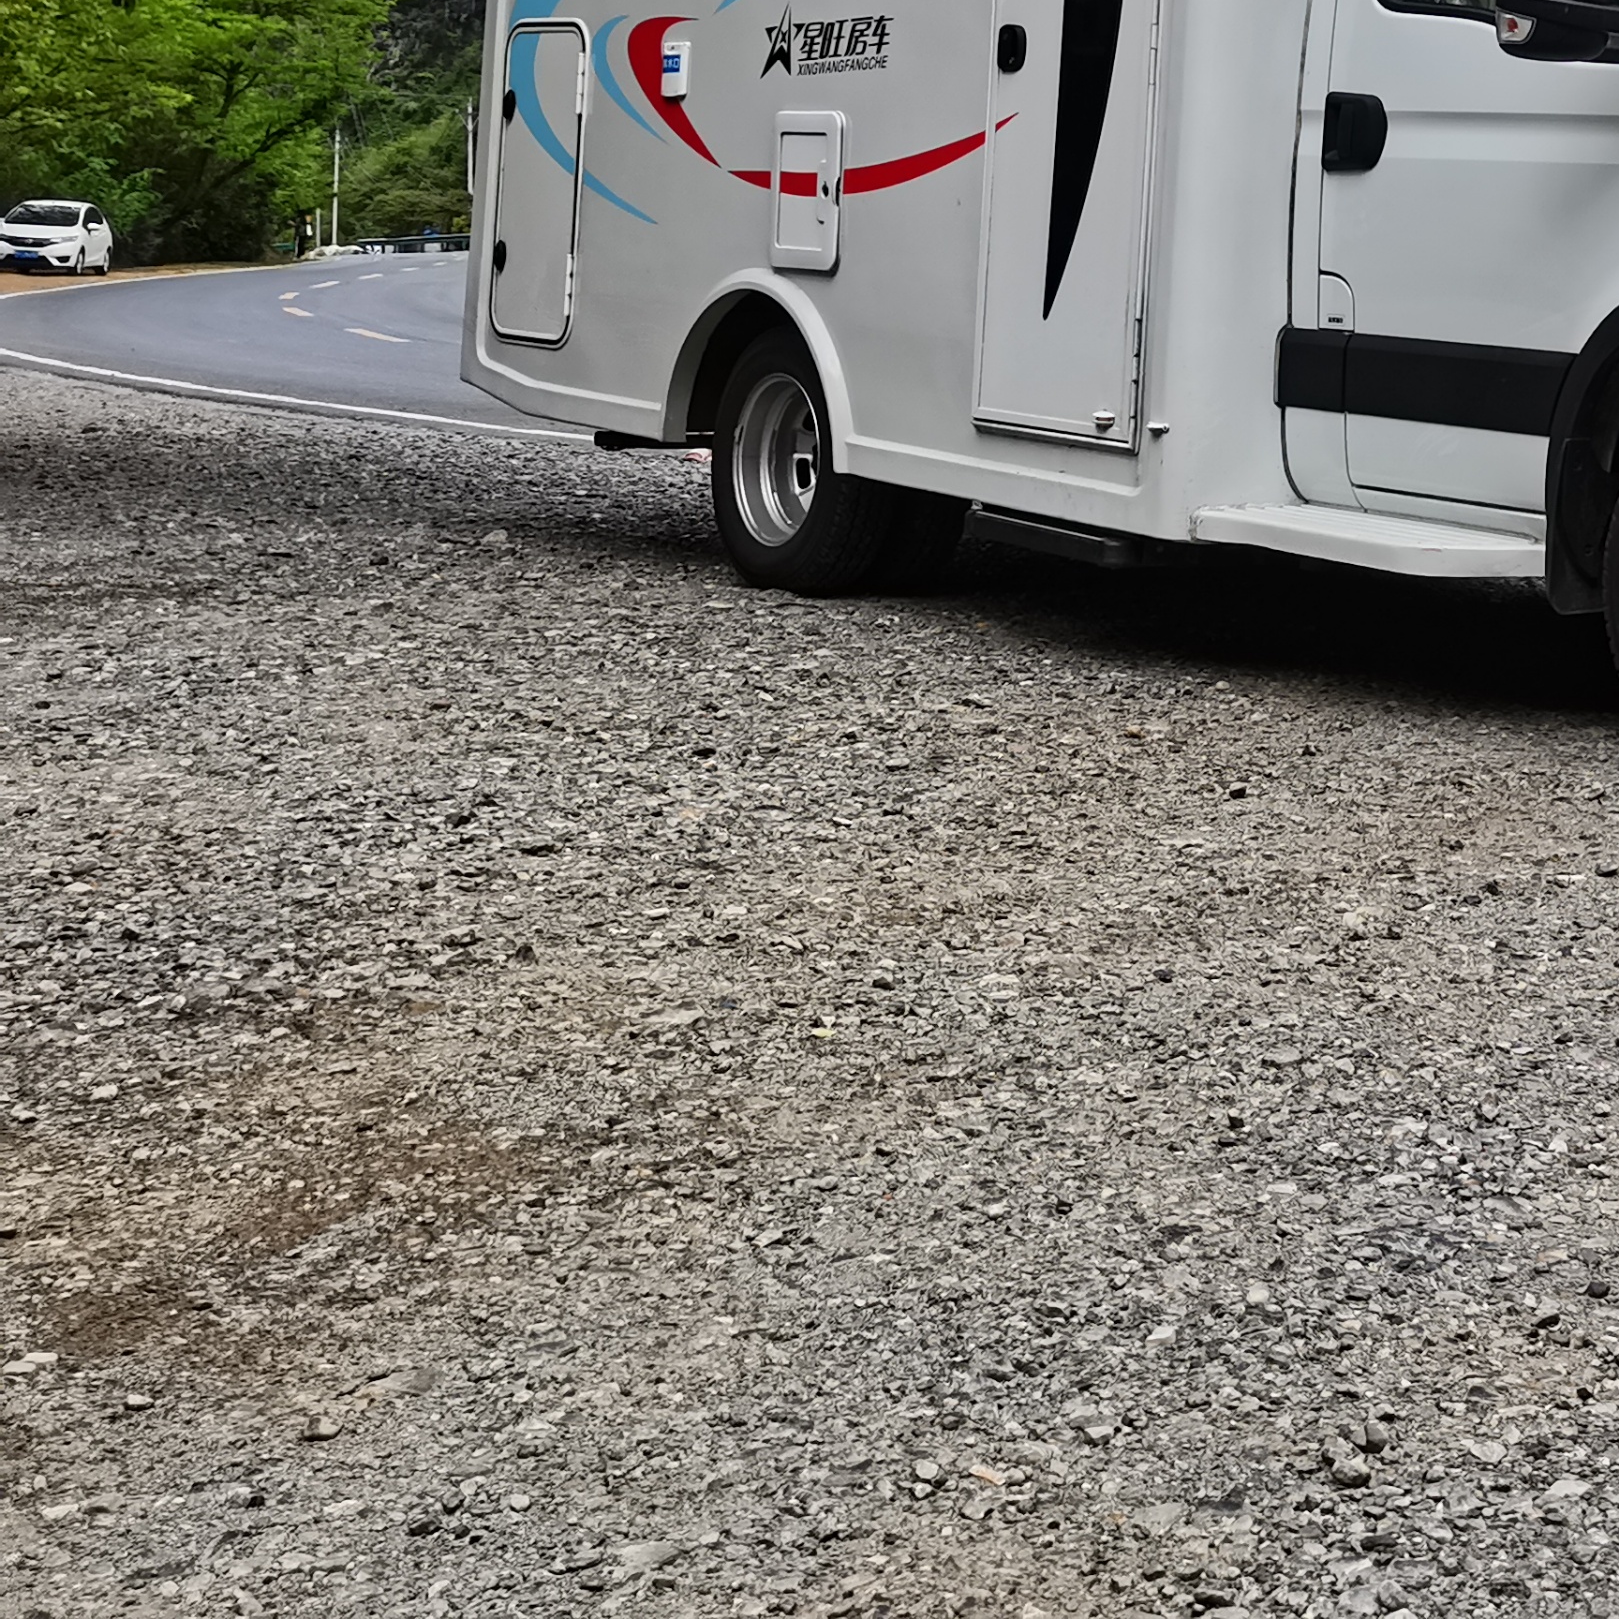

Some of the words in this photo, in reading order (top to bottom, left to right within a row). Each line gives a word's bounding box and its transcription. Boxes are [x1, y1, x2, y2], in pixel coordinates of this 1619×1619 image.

[797, 14, 895, 62] 星旺房车
[796, 55, 889, 77] XINGWANGFANGCHE
